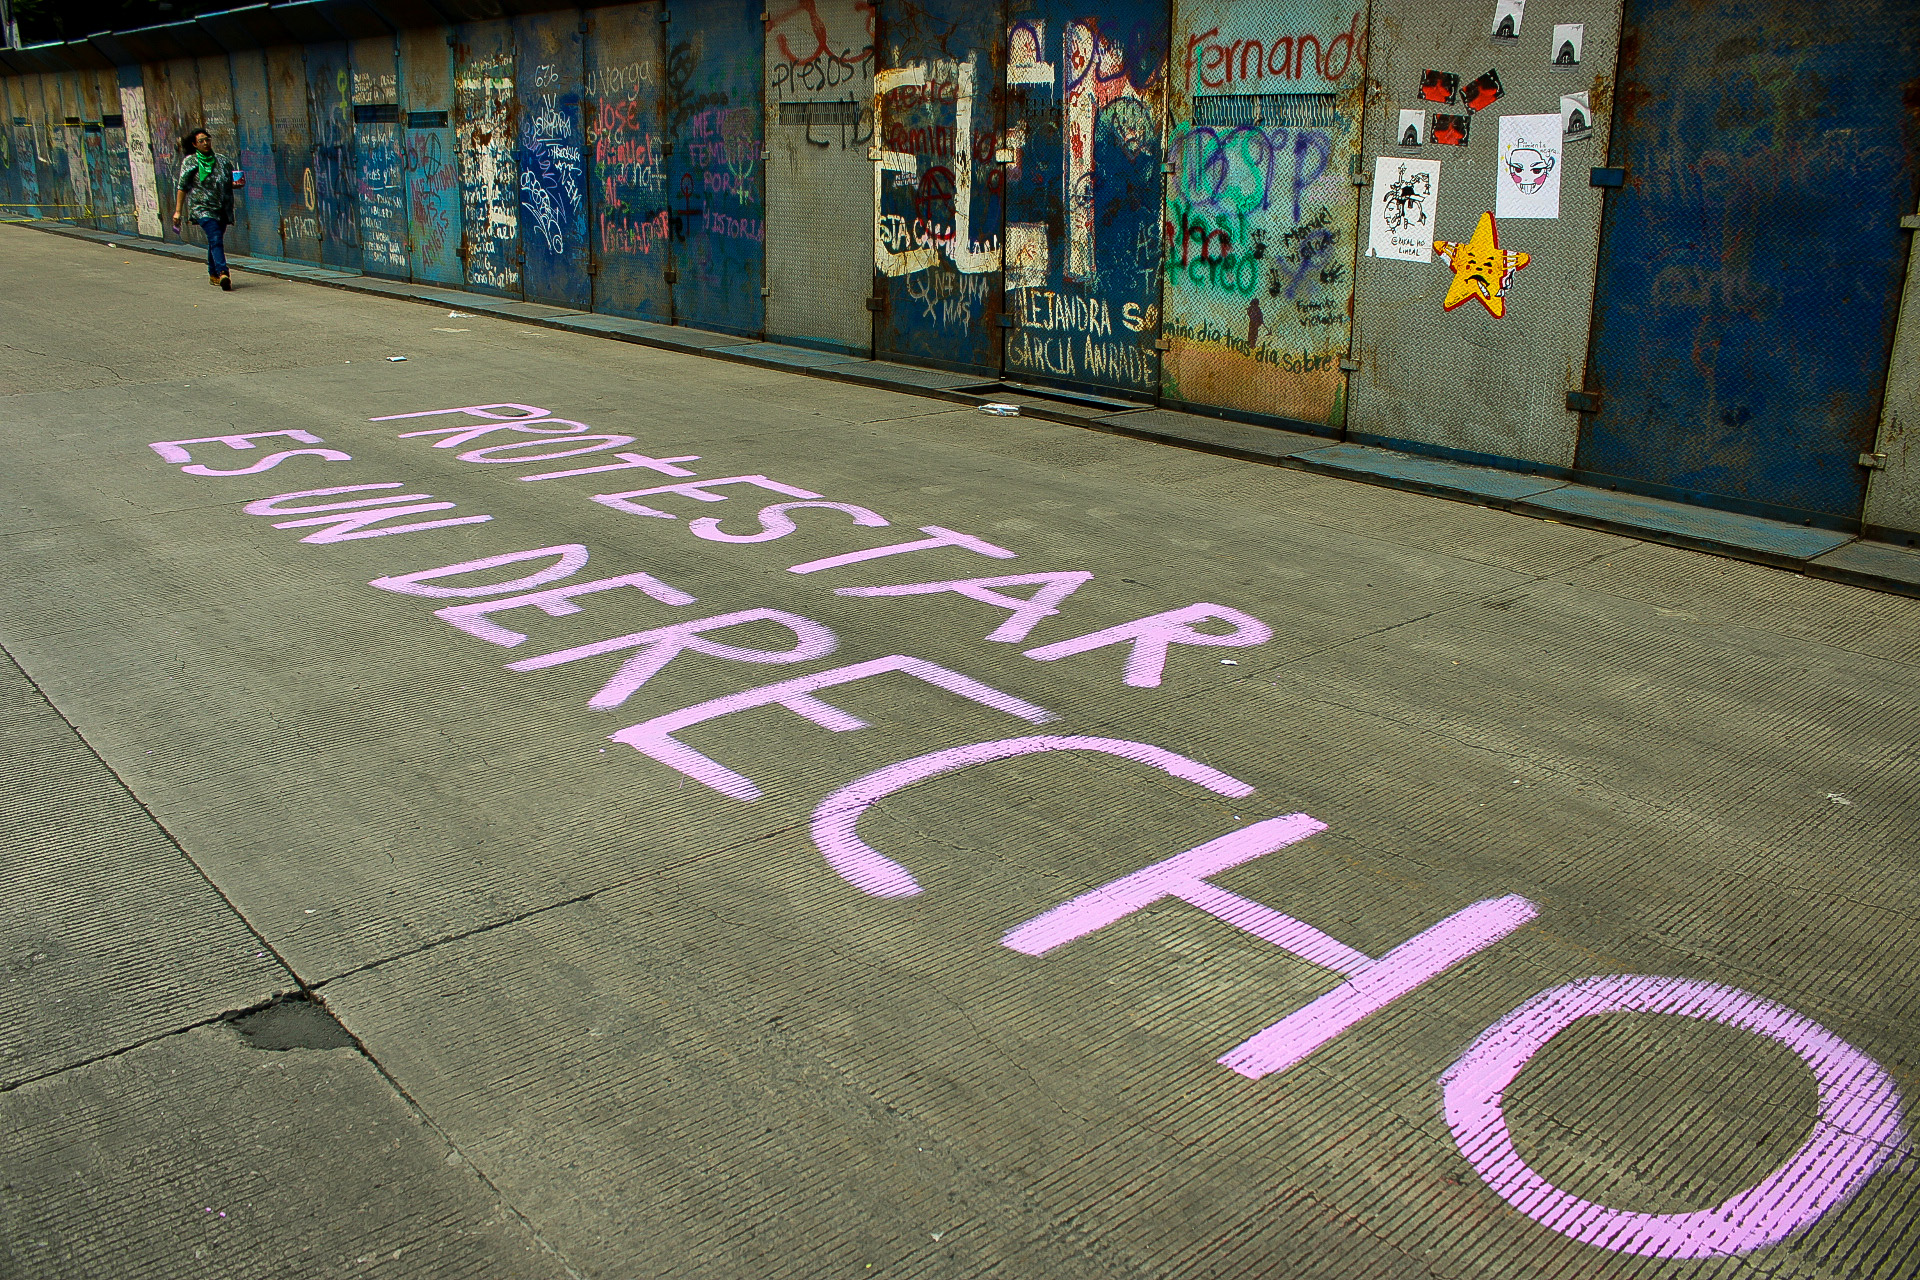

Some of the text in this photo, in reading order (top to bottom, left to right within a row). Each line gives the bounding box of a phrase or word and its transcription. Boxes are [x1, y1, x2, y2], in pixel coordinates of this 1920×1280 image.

[369, 402, 1274, 689] PROTESTAR
[148, 429, 1906, 1260] ES UN DERECHO
